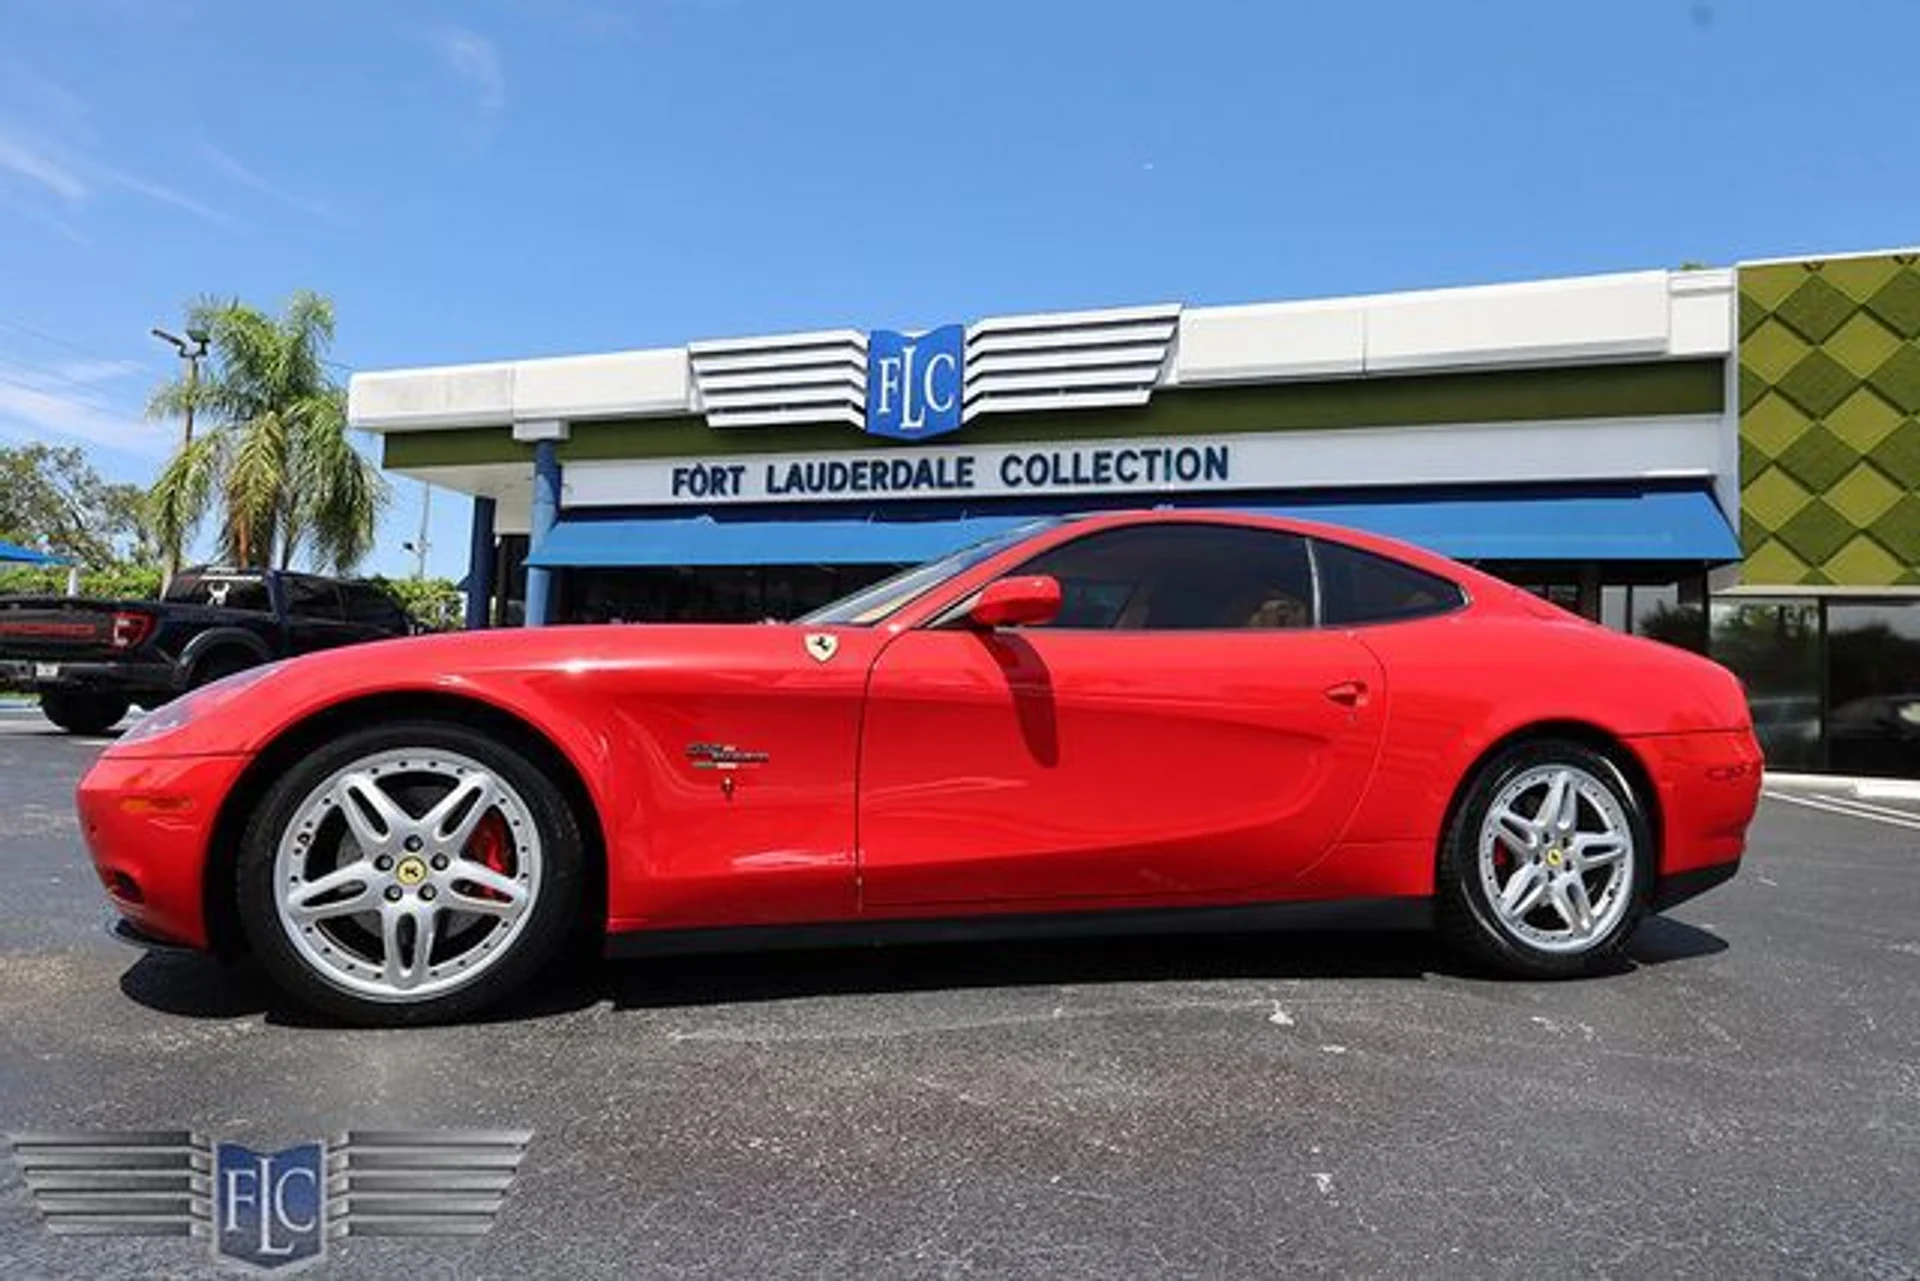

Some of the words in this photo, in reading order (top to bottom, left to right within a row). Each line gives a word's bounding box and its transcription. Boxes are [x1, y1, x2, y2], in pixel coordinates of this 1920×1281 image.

[878, 346, 955, 429] FLC
[672, 464, 745, 497] FORT
[767, 457, 975, 493] LAUDERDALE
[1001, 446, 1229, 485] COLLECTION
